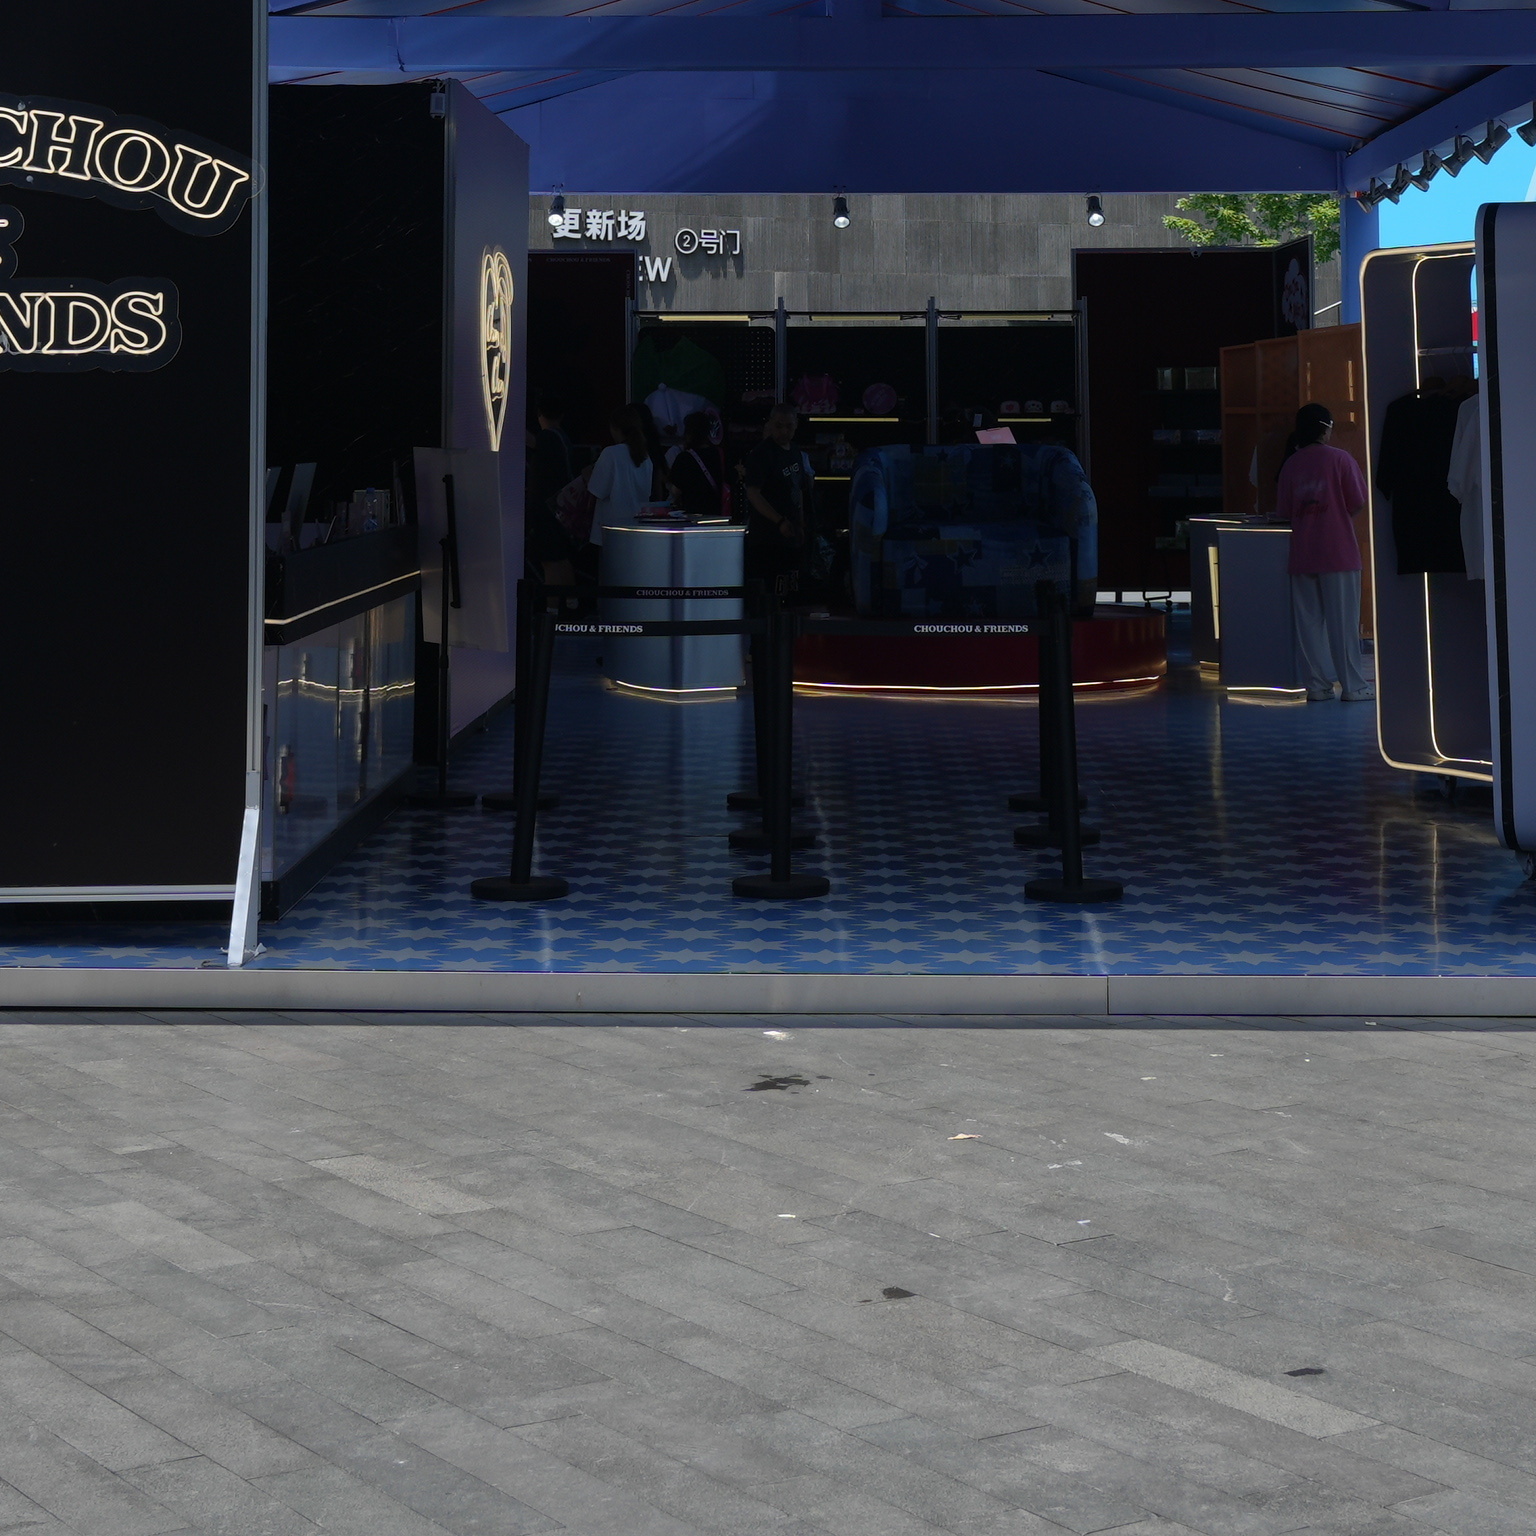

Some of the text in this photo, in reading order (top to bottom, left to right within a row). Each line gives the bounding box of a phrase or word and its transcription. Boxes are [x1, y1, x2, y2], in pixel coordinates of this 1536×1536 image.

[636, 589, 684, 597] CHOUCHOU
[692, 589, 729, 597] FRIENDS
[589, 624, 597, 633] &
[598, 624, 644, 634] FRIENDS
[914, 624, 1029, 633] CHOUCHOU & FRIENDS
